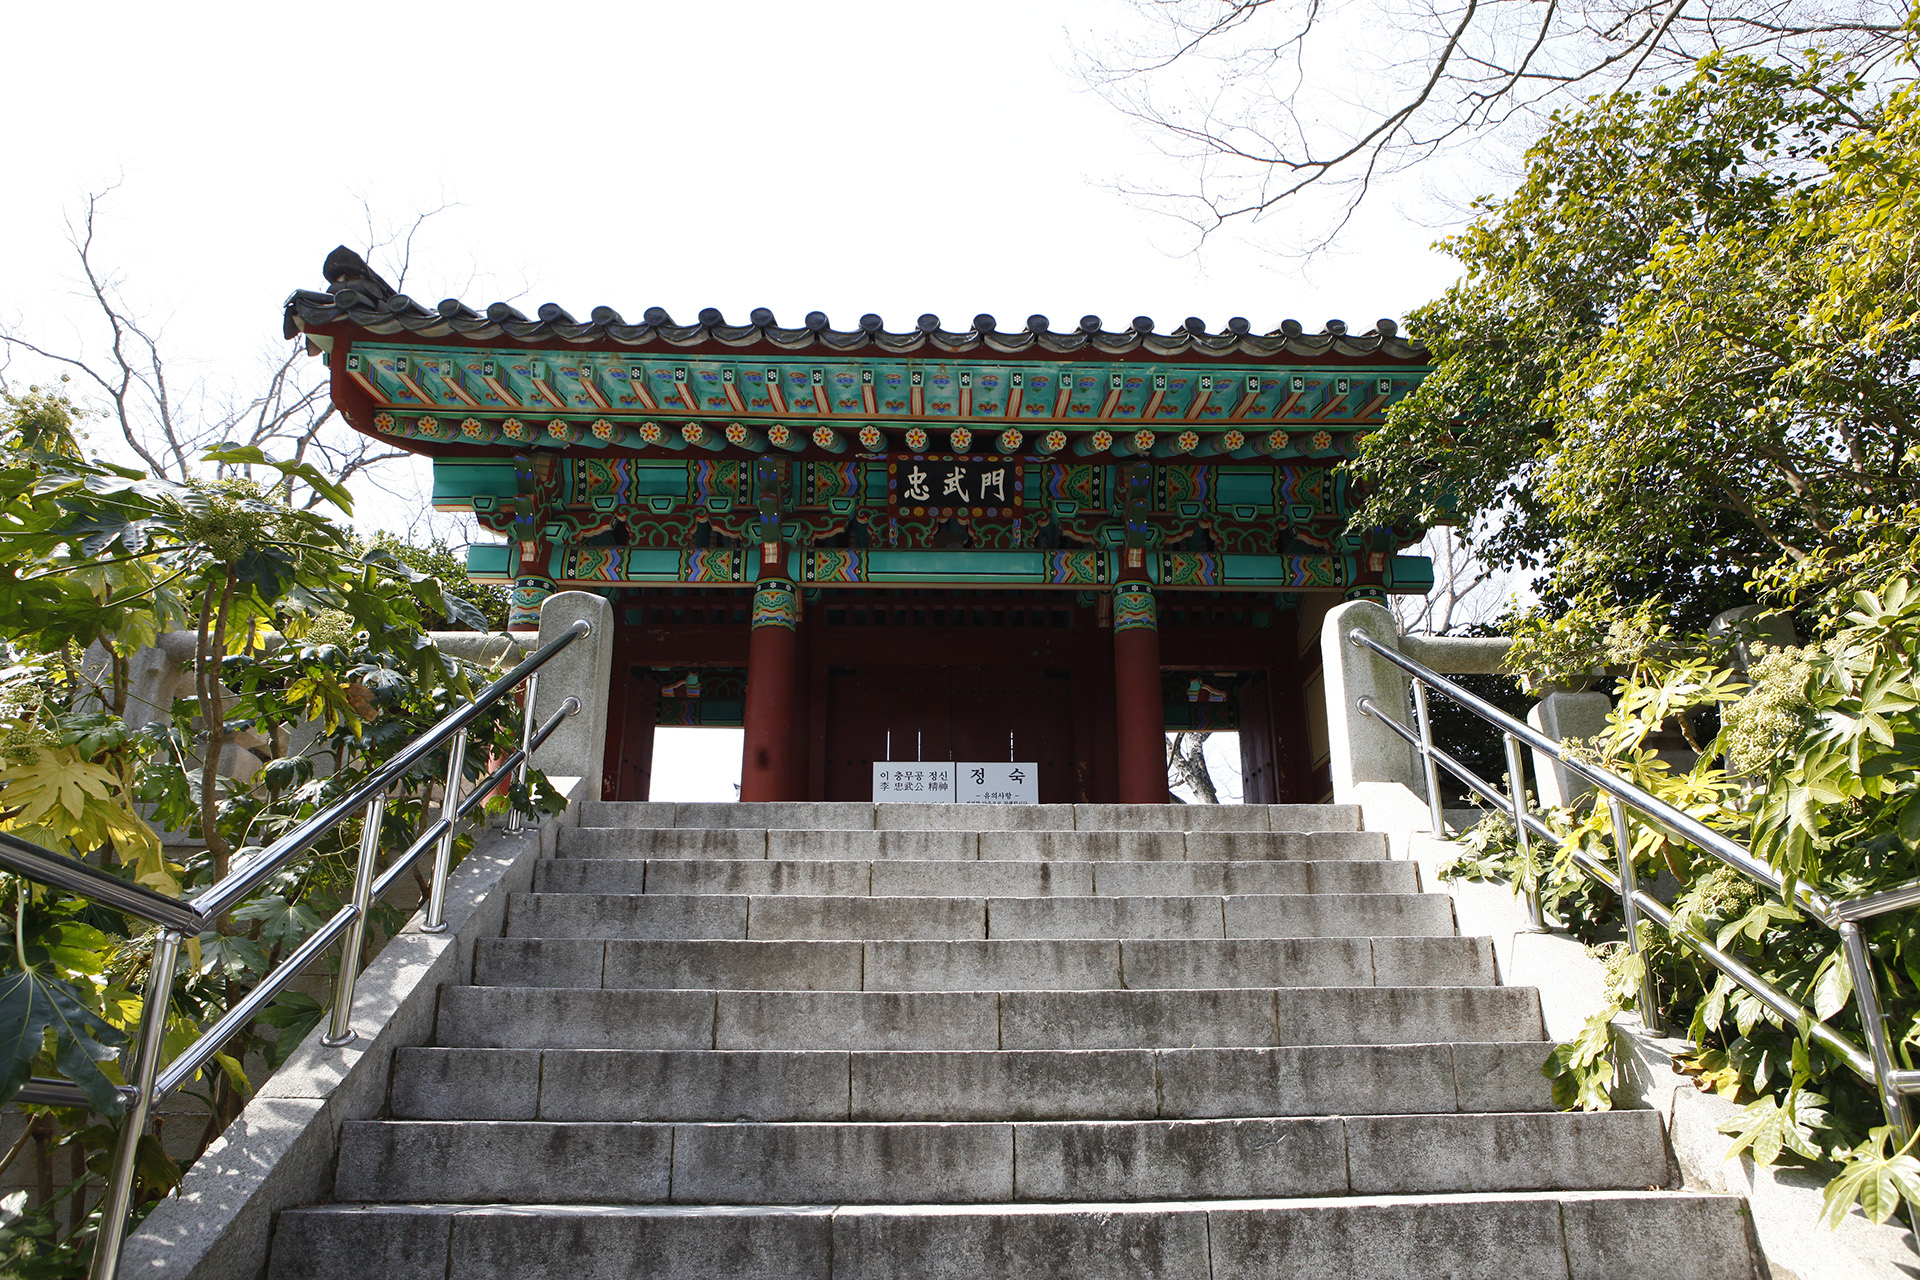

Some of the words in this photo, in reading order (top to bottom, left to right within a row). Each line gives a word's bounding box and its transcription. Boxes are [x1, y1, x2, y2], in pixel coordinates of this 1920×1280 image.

[904, 465, 1005, 503] 忠武門
[880, 771, 889, 781] 이
[894, 771, 924, 781] 충무공
[929, 771, 949, 781] 정신
[880, 782, 889, 792] 李
[894, 782, 924, 792] 忠武公
